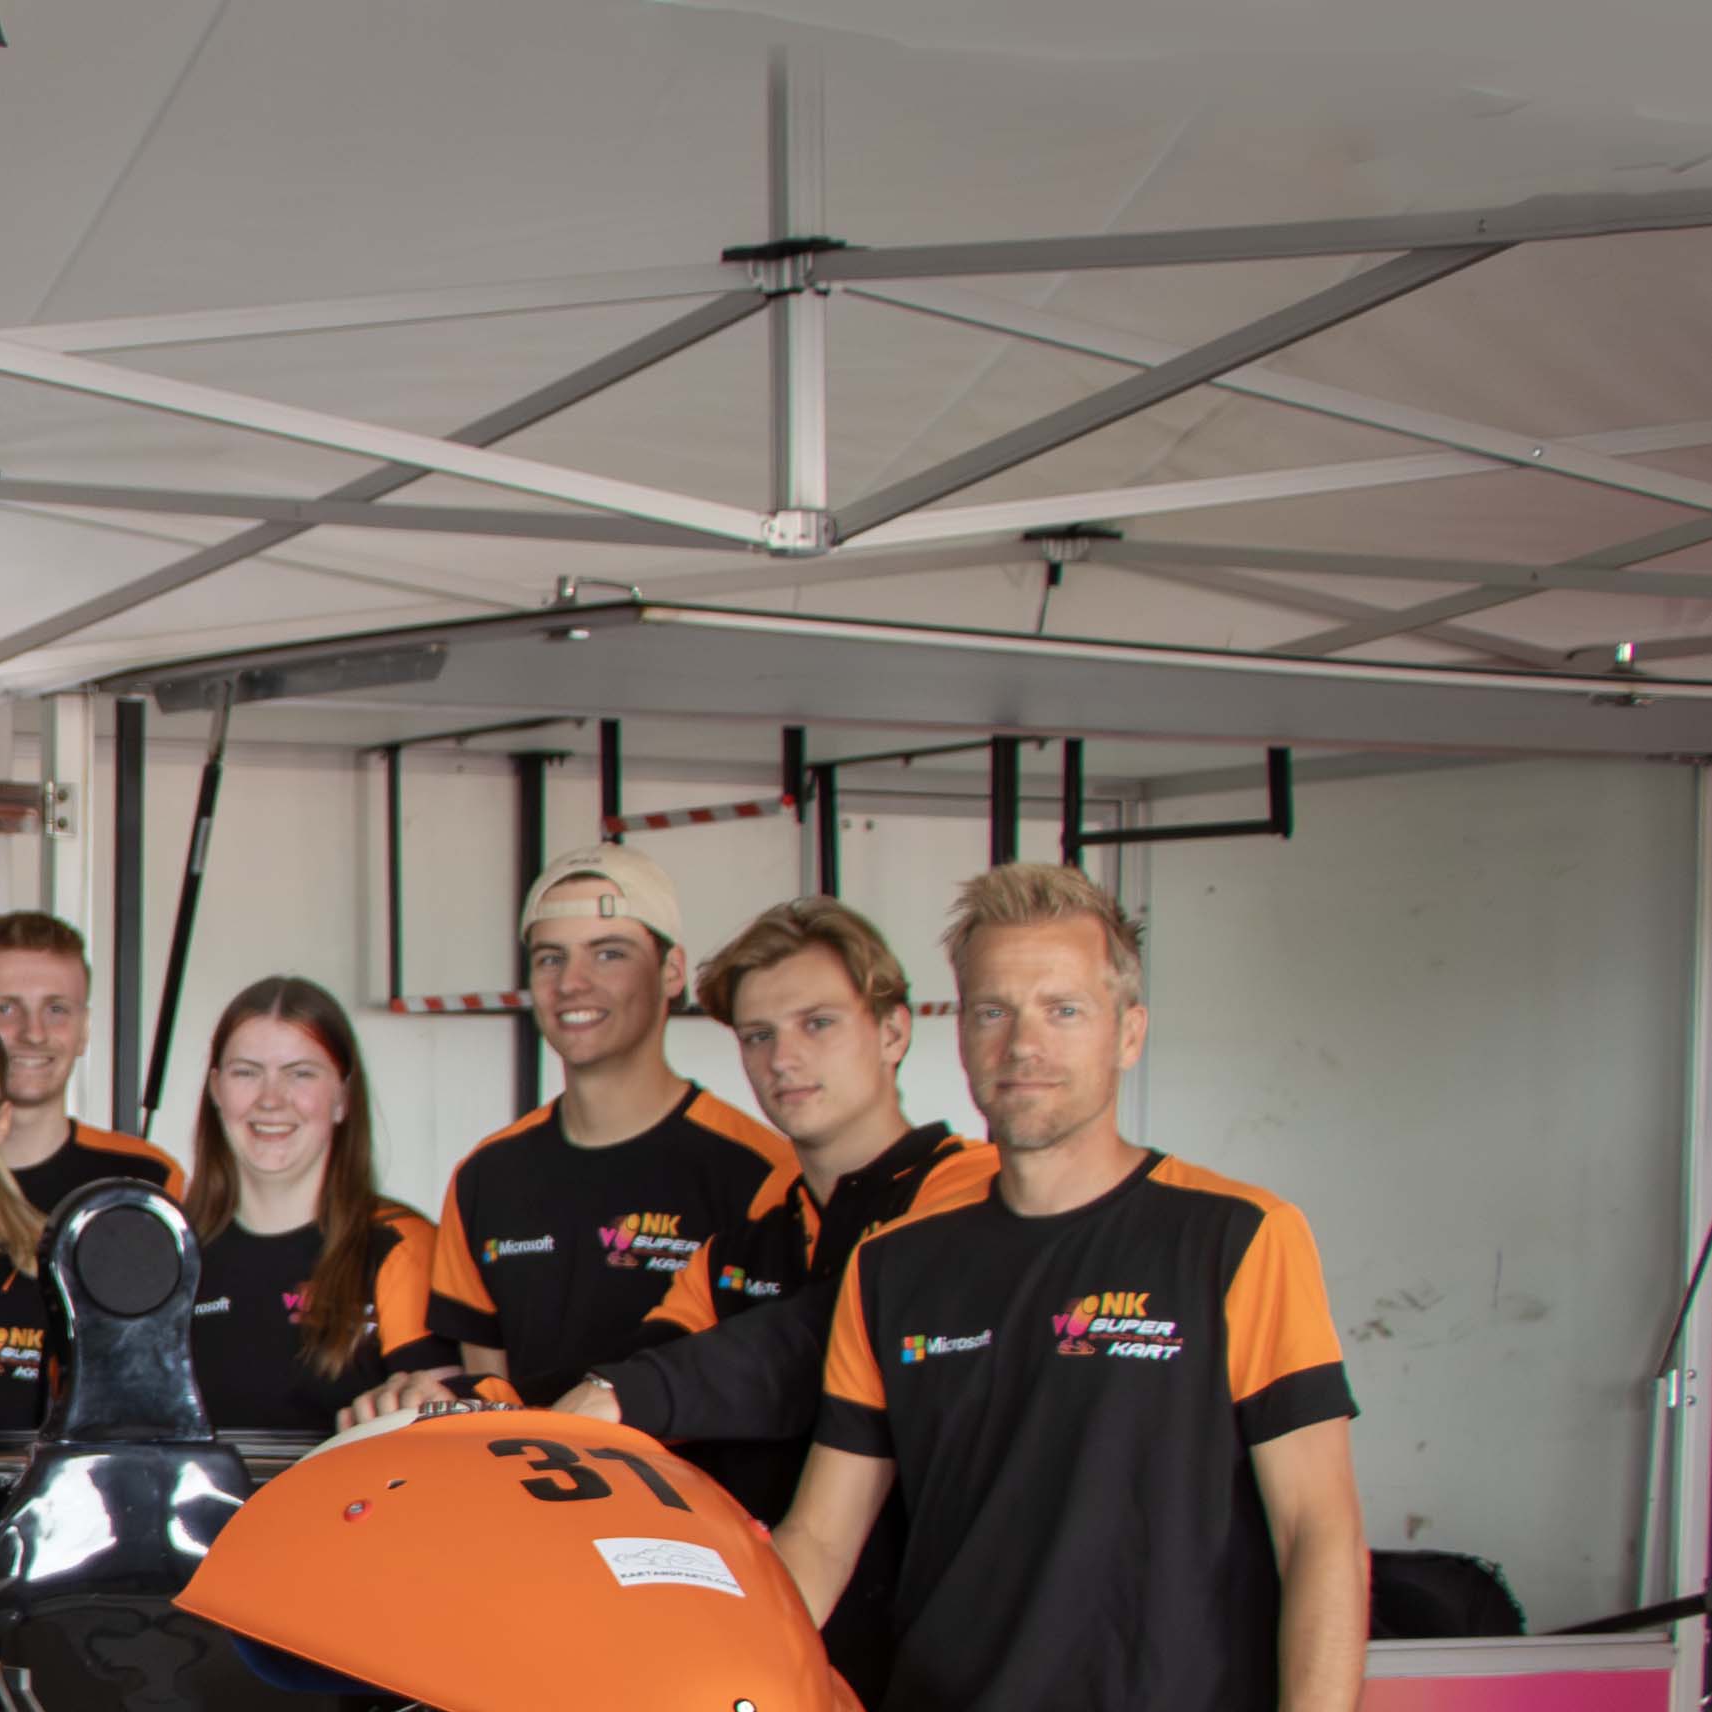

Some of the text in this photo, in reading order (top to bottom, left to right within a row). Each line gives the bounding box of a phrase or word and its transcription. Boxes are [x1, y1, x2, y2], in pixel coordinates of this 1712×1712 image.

[498, 1235, 554, 1256] Microsoft
[195, 1297, 230, 1315] rosoft
[1089, 1318, 1176, 1336] SUPER
[927, 1329, 992, 1354] Microsoft
[1105, 1342, 1182, 1360] KART
[486, 1438, 694, 1513] 31
